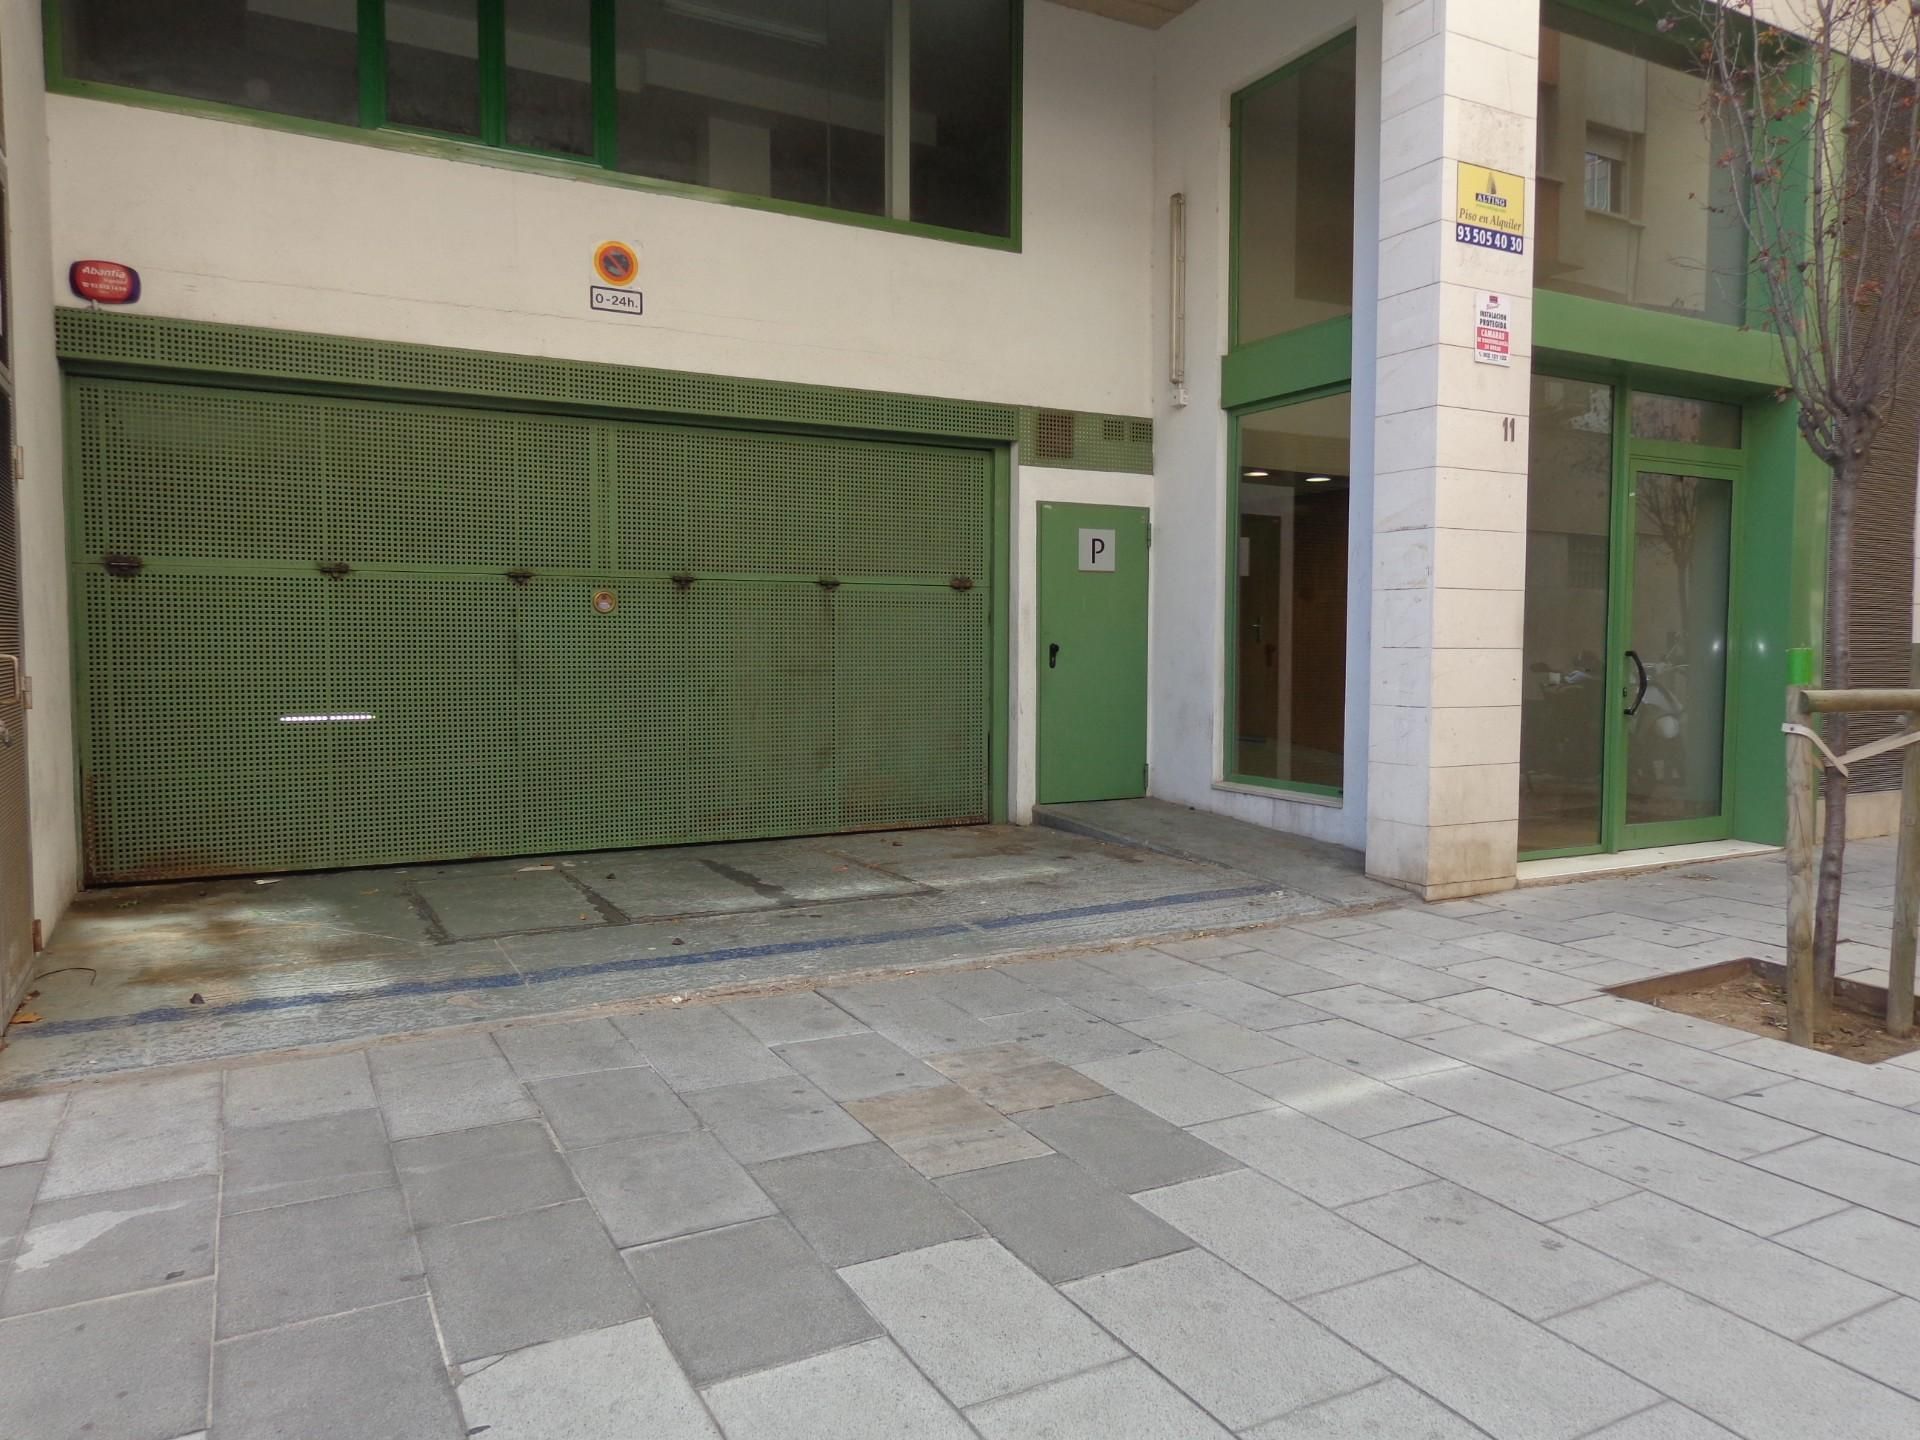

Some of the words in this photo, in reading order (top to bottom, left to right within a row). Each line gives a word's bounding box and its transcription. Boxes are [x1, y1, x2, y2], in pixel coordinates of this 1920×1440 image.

[1477, 195, 1505, 206] ALTING
[1459, 207, 1477, 221] Piso
[1479, 214, 1488, 224] en
[1490, 215, 1521, 230] Alquiler
[1458, 225, 1471, 241] 93
[1472, 228, 1492, 245] 505
[1494, 232, 1507, 249] 40
[1510, 236, 1522, 252] 30
[1479, 318, 1507, 330] PROTEGIDA
[1502, 417, 1515, 442] 11
[1091, 538, 1105, 564] P
